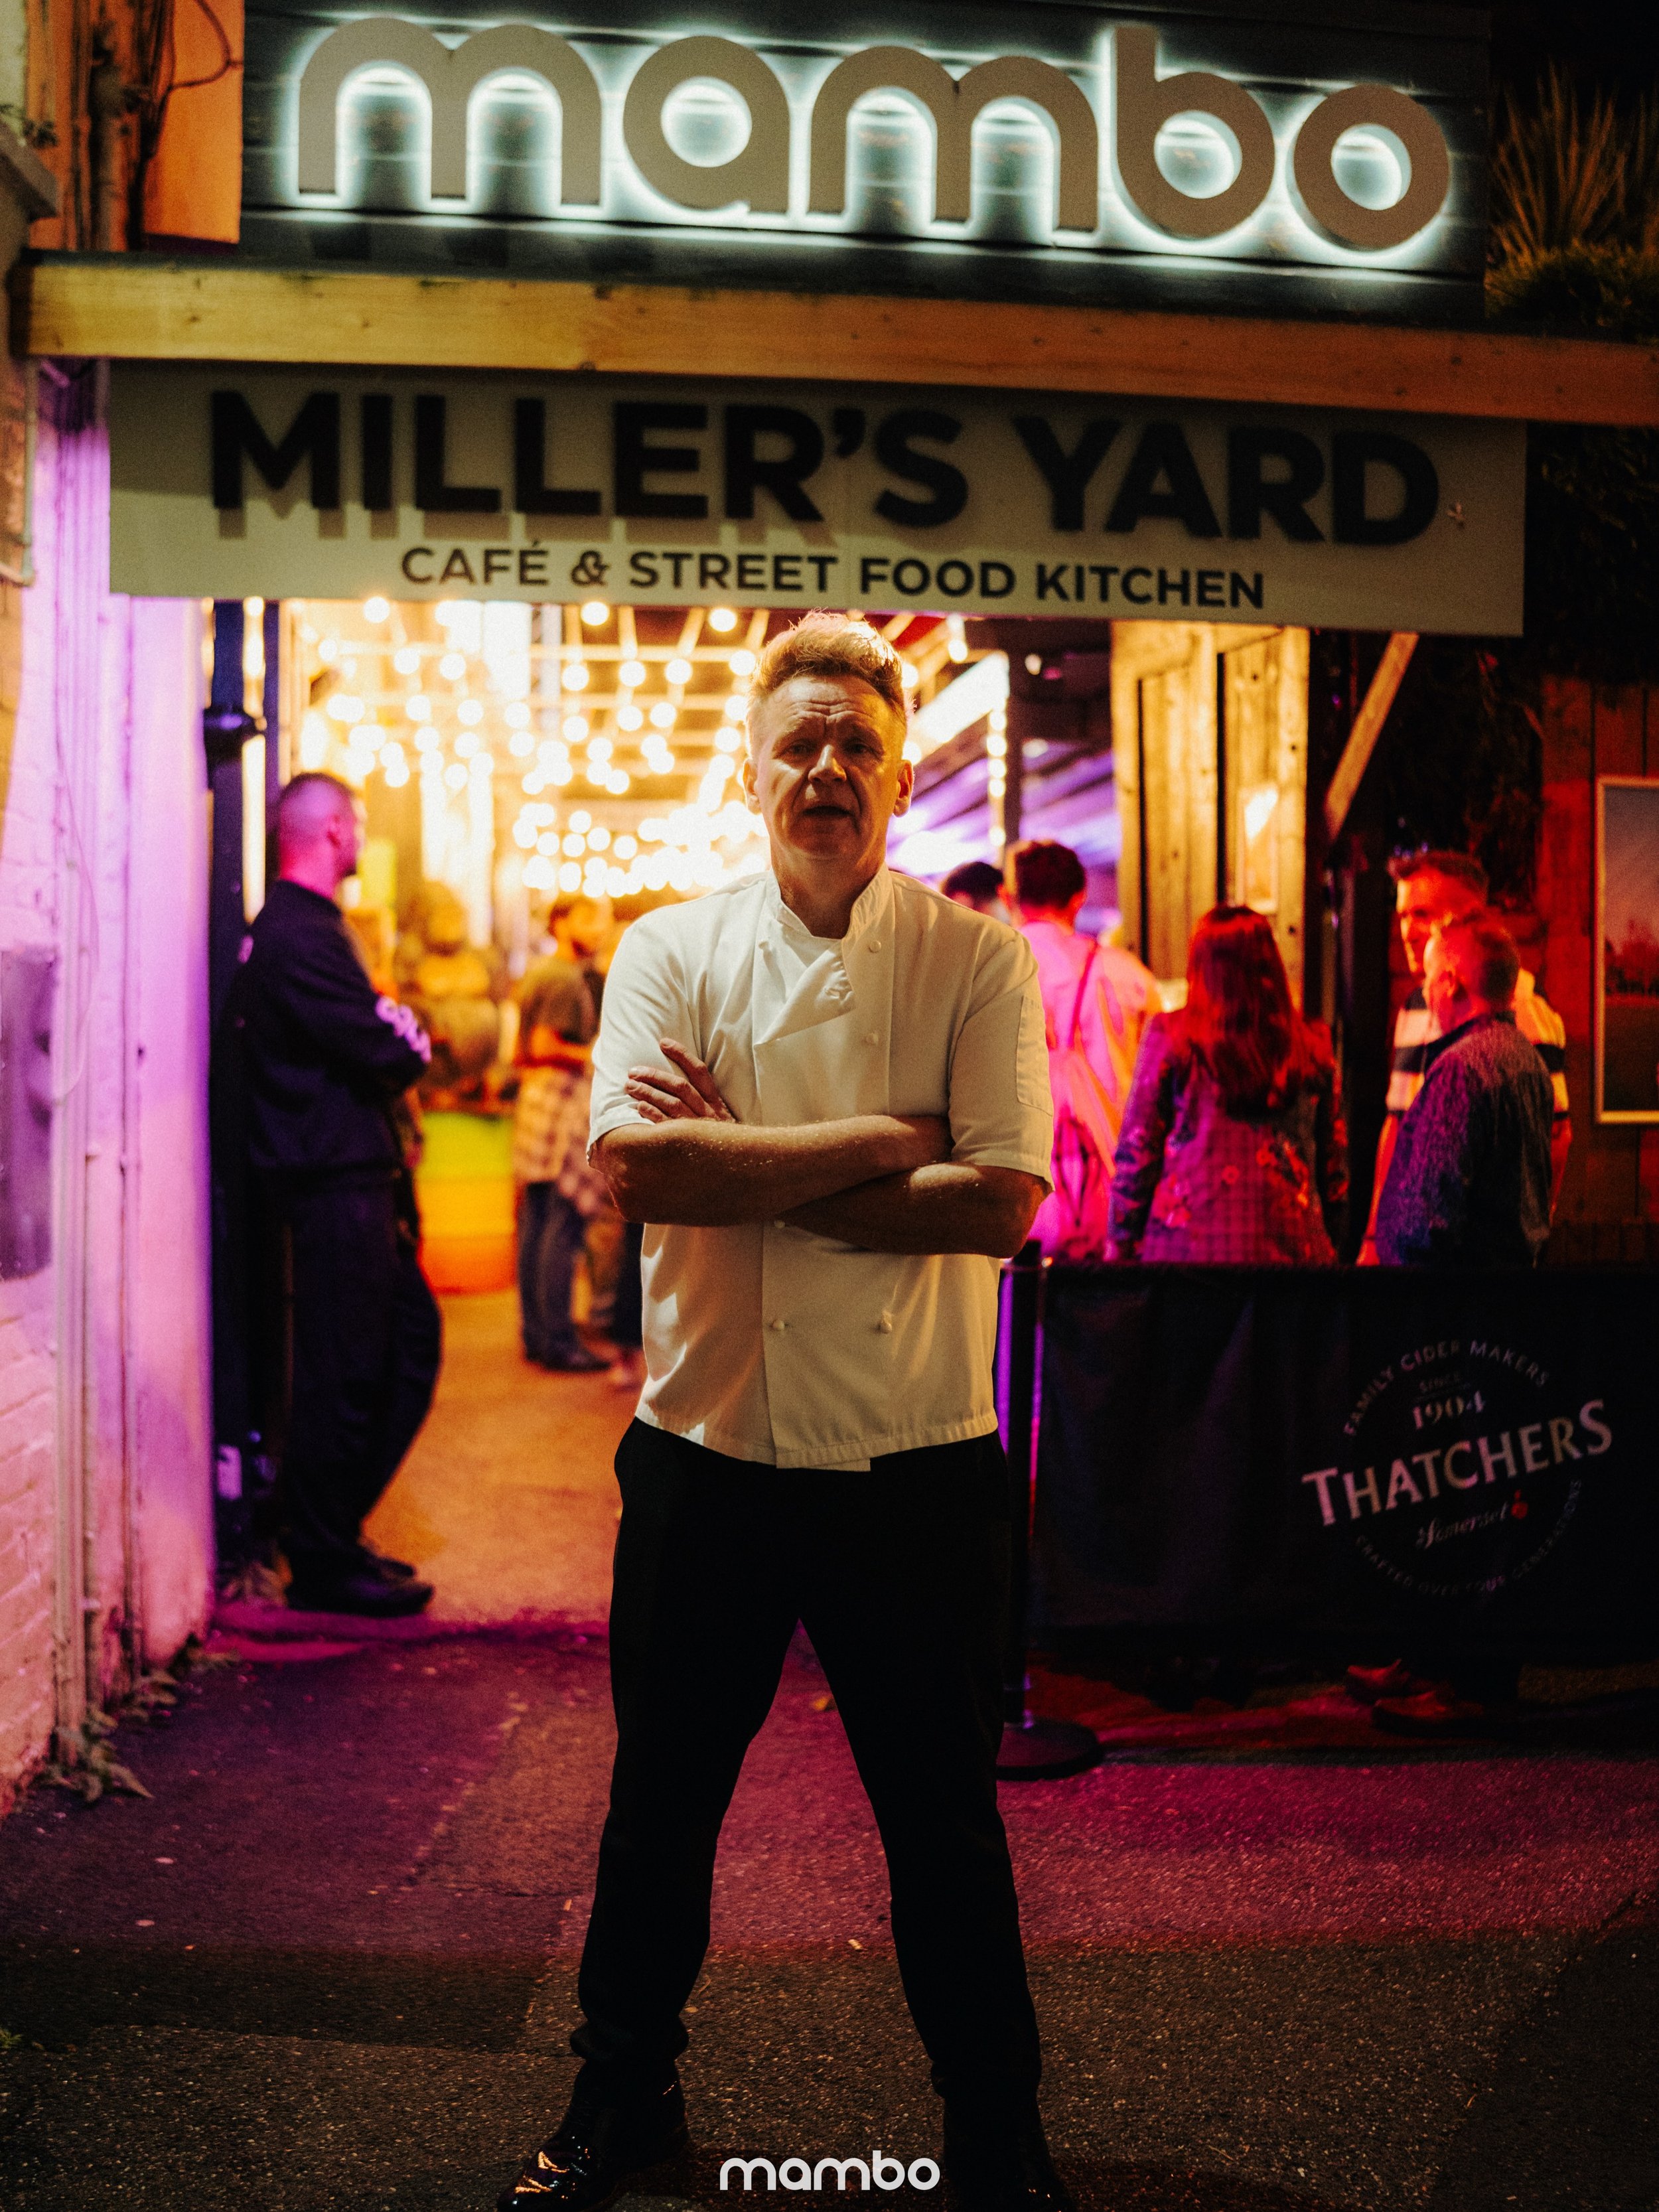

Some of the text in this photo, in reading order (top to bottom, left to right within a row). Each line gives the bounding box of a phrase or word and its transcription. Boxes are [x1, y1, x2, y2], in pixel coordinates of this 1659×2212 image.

[297, 15, 1451, 250] mambo
[1013, 415, 1439, 546] YARD
[401, 540, 1264, 609] CAFÉ & STREET FOOD KITCHEN
[1342, 1339, 1551, 1436] FAMILY CIDER MAKERS
[1411, 1389, 1486, 1431] 1904
[1301, 1398, 1613, 1527] THATCHERS
[1354, 1534, 1415, 1588] CRAFTED
[1415, 1501, 1509, 1550] Somerset
